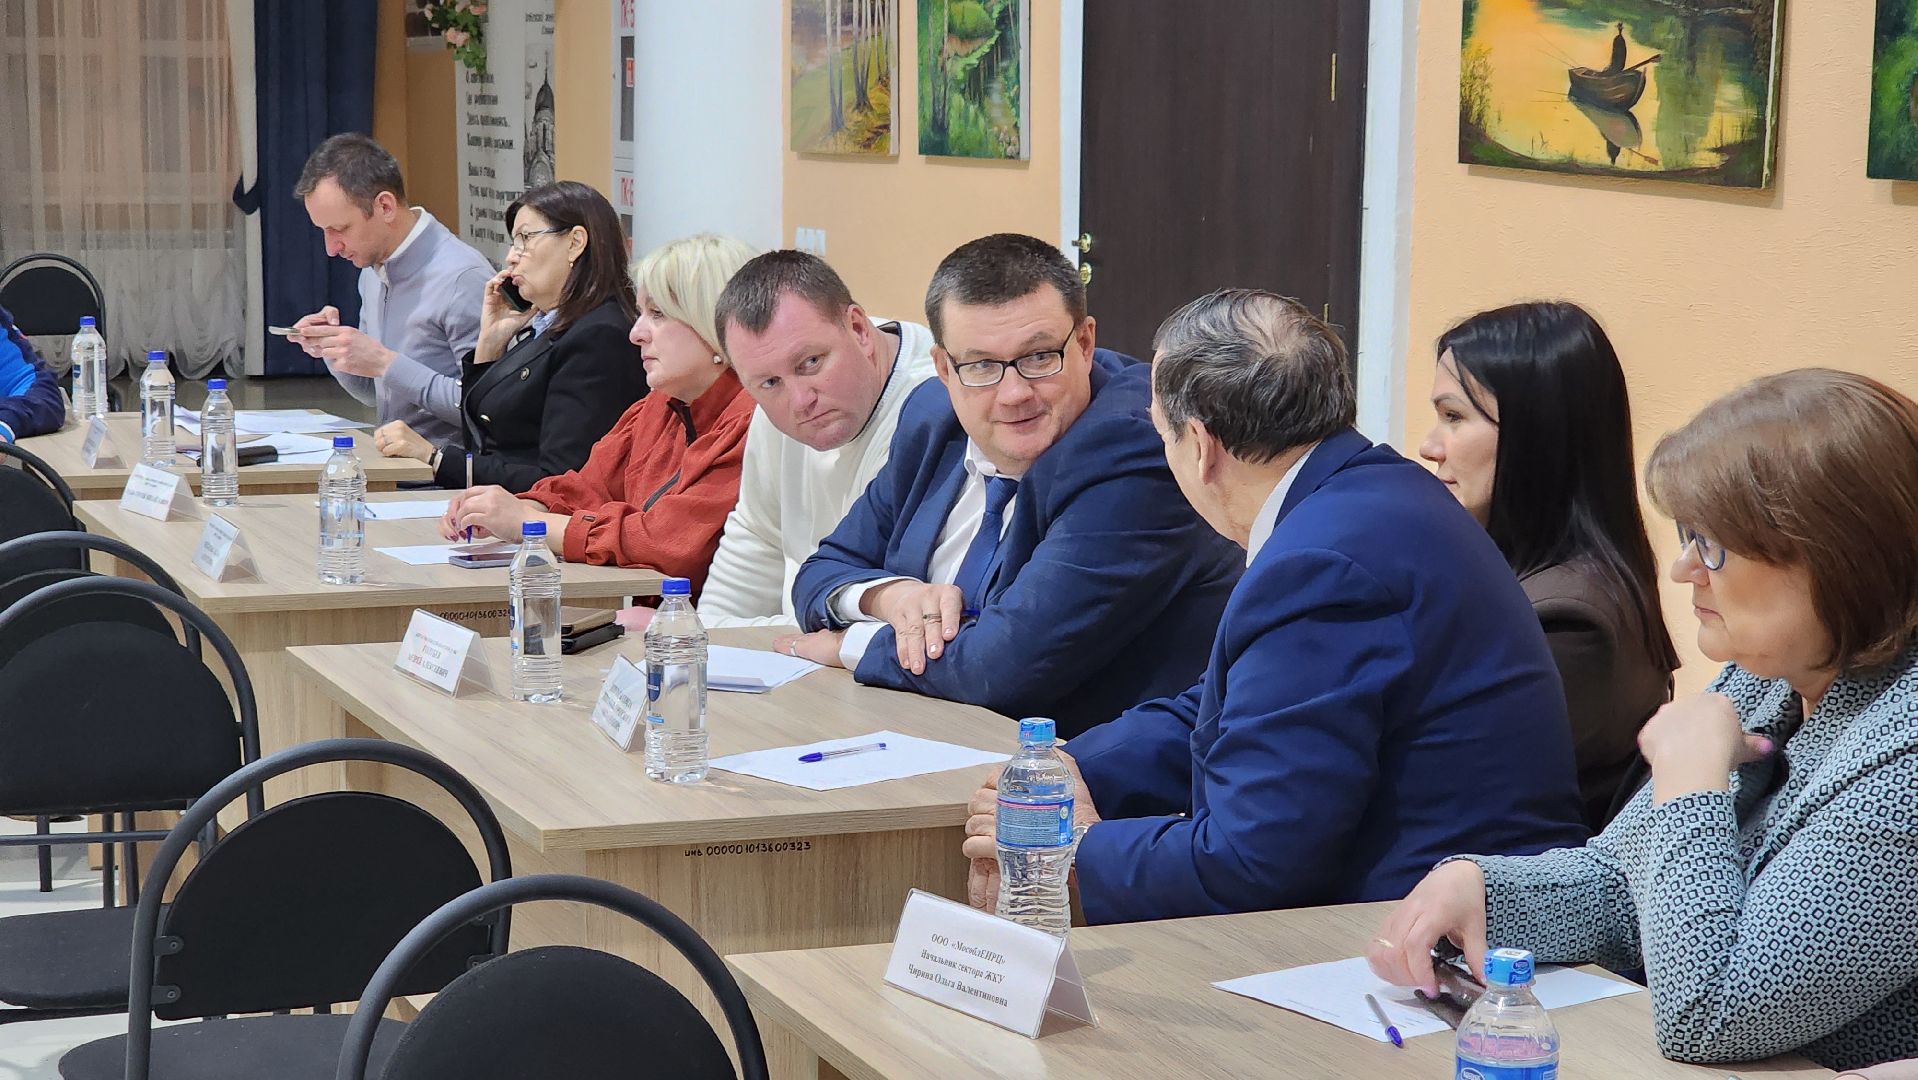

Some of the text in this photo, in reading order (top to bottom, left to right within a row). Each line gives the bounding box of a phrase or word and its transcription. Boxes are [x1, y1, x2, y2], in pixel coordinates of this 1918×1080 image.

[931, 933, 949, 947] ООО
[908, 963, 1008, 1007] Чирина Ольга Валентиновна
[920, 949, 1005, 985] Начальник сектора ЖКУ
